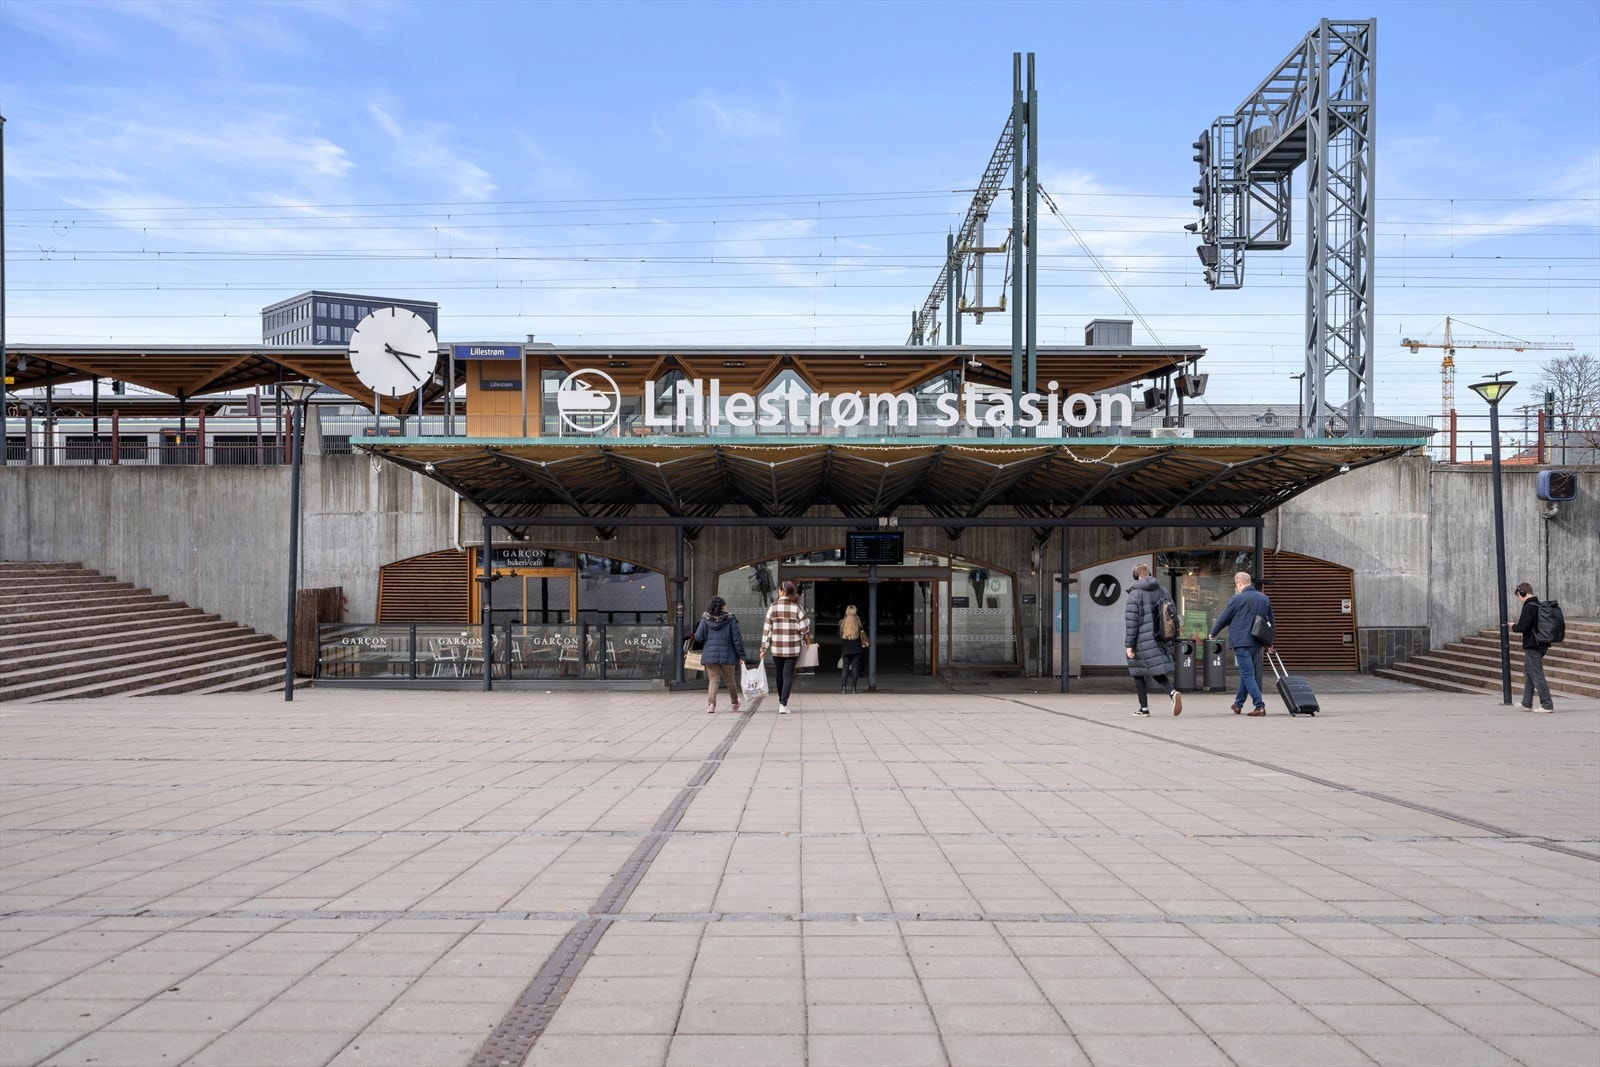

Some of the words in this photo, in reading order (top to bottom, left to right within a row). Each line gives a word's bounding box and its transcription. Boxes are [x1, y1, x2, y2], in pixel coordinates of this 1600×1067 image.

[470, 348, 504, 357] Lillestrøm
[644, 378, 919, 429] Lillestrøm
[936, 380, 1132, 438] stasjon
[503, 549, 546, 559] GARÇON
[342, 637, 387, 646] GARÇON
[438, 637, 483, 647] GARÇON
[533, 637, 579, 646] GARÇON
